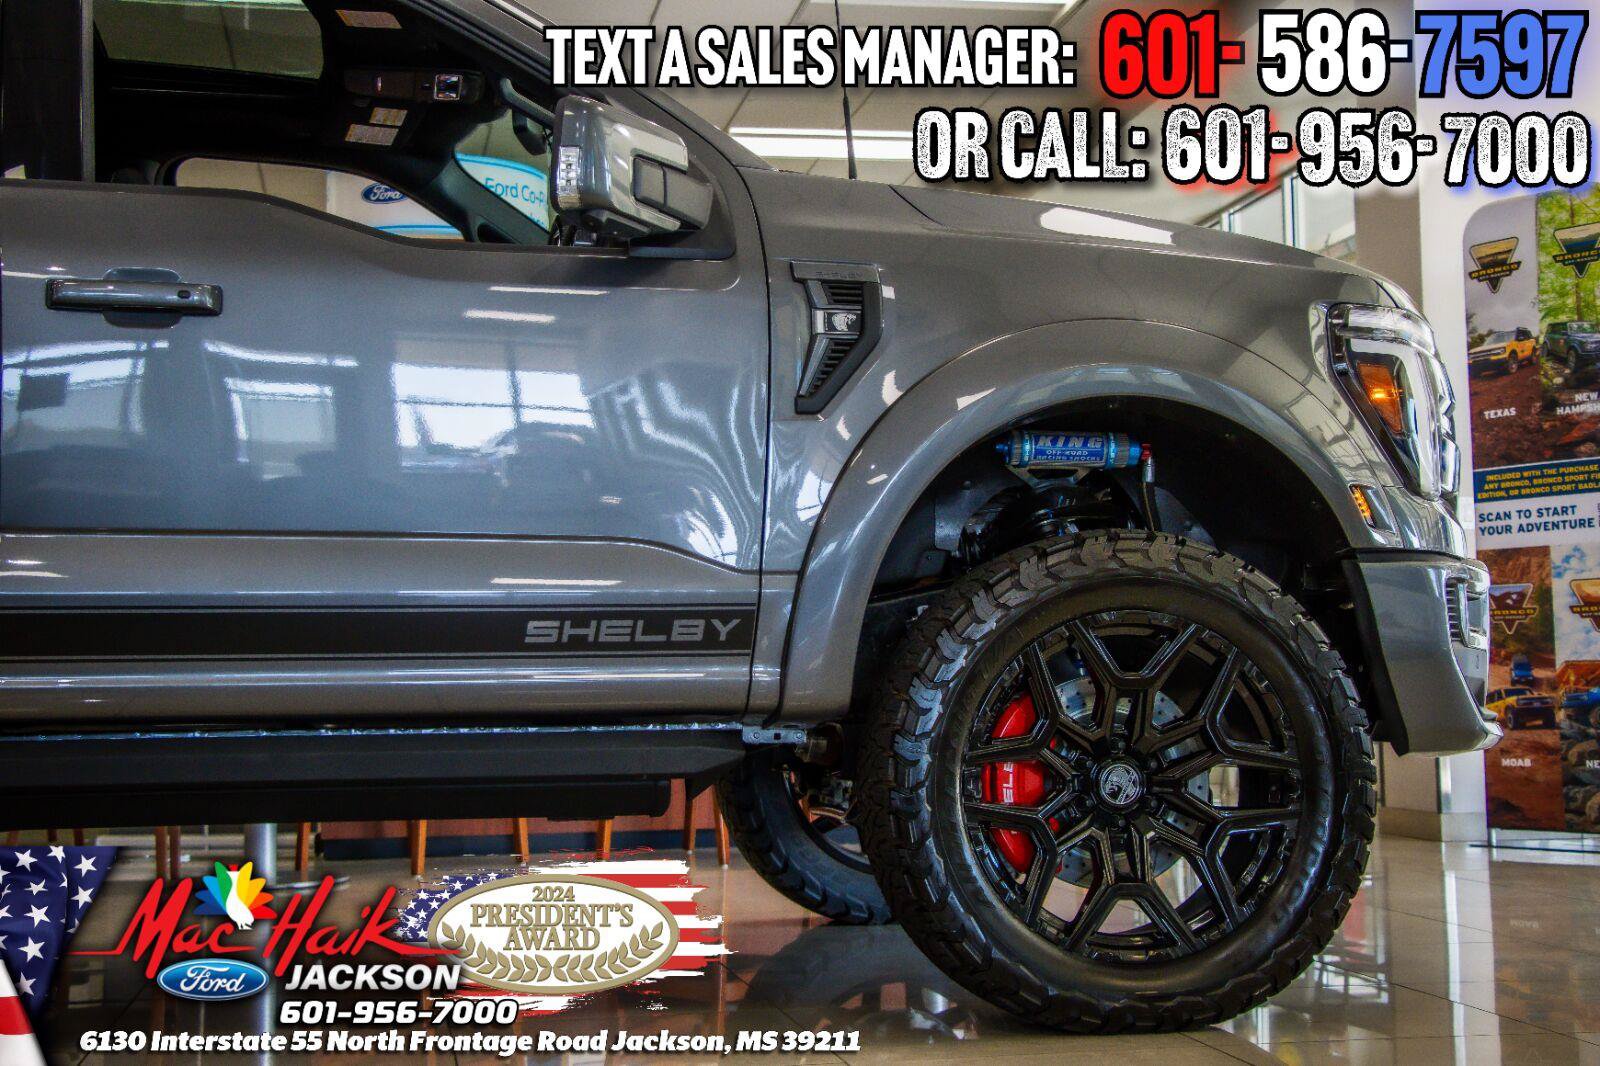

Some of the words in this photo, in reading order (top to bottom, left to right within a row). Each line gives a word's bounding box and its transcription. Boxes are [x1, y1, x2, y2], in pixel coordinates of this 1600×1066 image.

[484, 177, 519, 198] Ford
[1471, 263, 1518, 279] BRONCO
[1575, 392, 1599, 402] NEW
[1483, 407, 1516, 419] TEXAS
[1036, 435, 1104, 448] KING
[1486, 472, 1521, 481] INCLUDED
[1522, 470, 1541, 478] WITH
[1559, 464, 1599, 474] PURCHASE
[1484, 482, 1498, 490] ANY
[1533, 477, 1562, 485] BRONCO
[1565, 474, 1589, 482] SPORT
[1509, 488, 1520, 496] OR
[1521, 486, 1550, 495] BRONCO
[1552, 484, 1576, 492] SPORT
[1479, 510, 1512, 523] SCAN
[1516, 508, 1532, 519] TO
[1536, 505, 1578, 519] START
[1479, 524, 1513, 536] YOUR
[1517, 517, 1595, 534] ADVENTURE
[524, 618, 742, 643] SHELBY
[1501, 757, 1532, 768] MOAB
